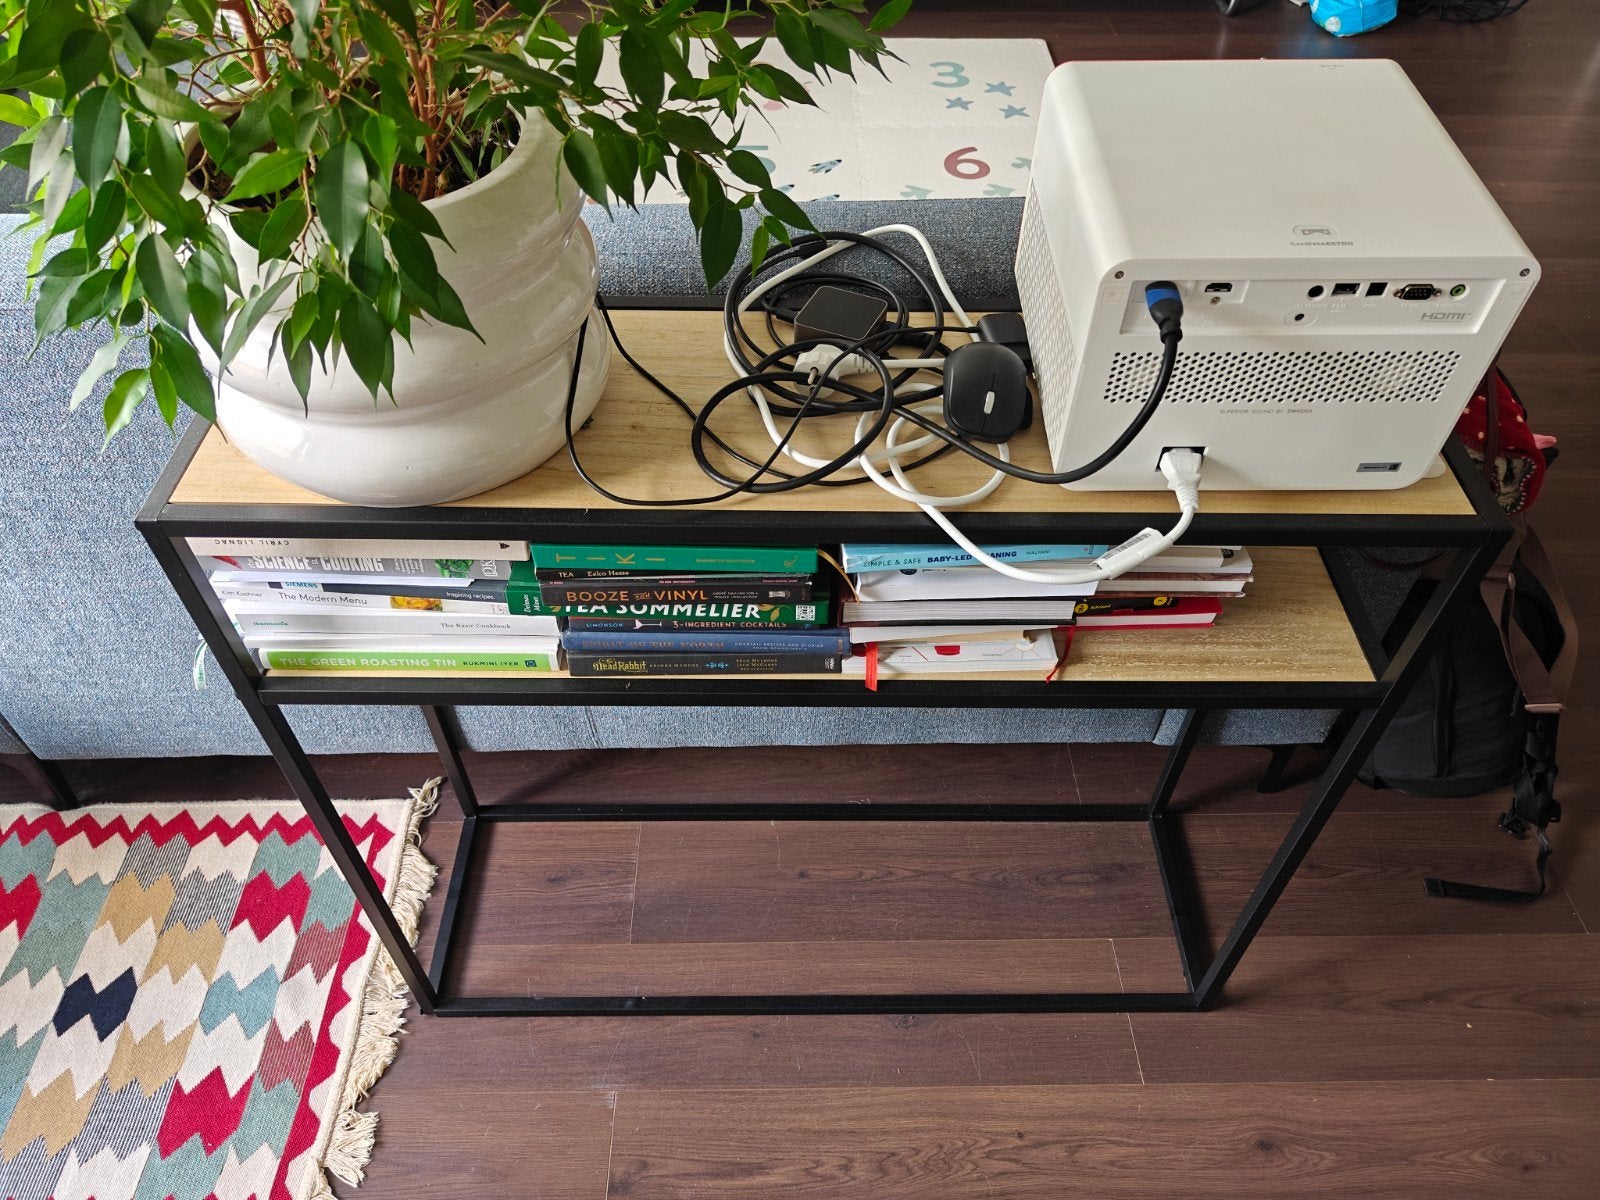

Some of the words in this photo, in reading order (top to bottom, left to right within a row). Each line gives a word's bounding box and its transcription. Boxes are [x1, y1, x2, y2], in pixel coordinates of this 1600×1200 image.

[928, 61, 971, 88] 3
[943, 146, 991, 180] 6
[1420, 312, 1467, 321] HDMI
[253, 556, 312, 571] SCIENCE
[320, 557, 385, 572] COOKING
[863, 559, 892, 567] SIMPLE
[903, 557, 922, 565] SAFE
[927, 554, 972, 563] BABY-LED
[987, 551, 1018, 560] ANING
[285, 581, 318, 589] SIEMENS
[279, 591, 296, 600] The
[298, 593, 336, 603] Modern
[340, 595, 368, 605] Menu
[446, 592, 472, 600] Inspiring
[566, 590, 629, 602] BOOZE
[653, 590, 709, 601] VINYL
[616, 603, 760, 619] SOMMELIER
[673, 620, 735, 629] 3-INGREDIENT
[279, 657, 307, 666] THE
[311, 658, 356, 666] GREEN
[360, 658, 430, 667] ROASTING
[433, 659, 457, 667] TIN
[618, 660, 647, 671] Rabbit
